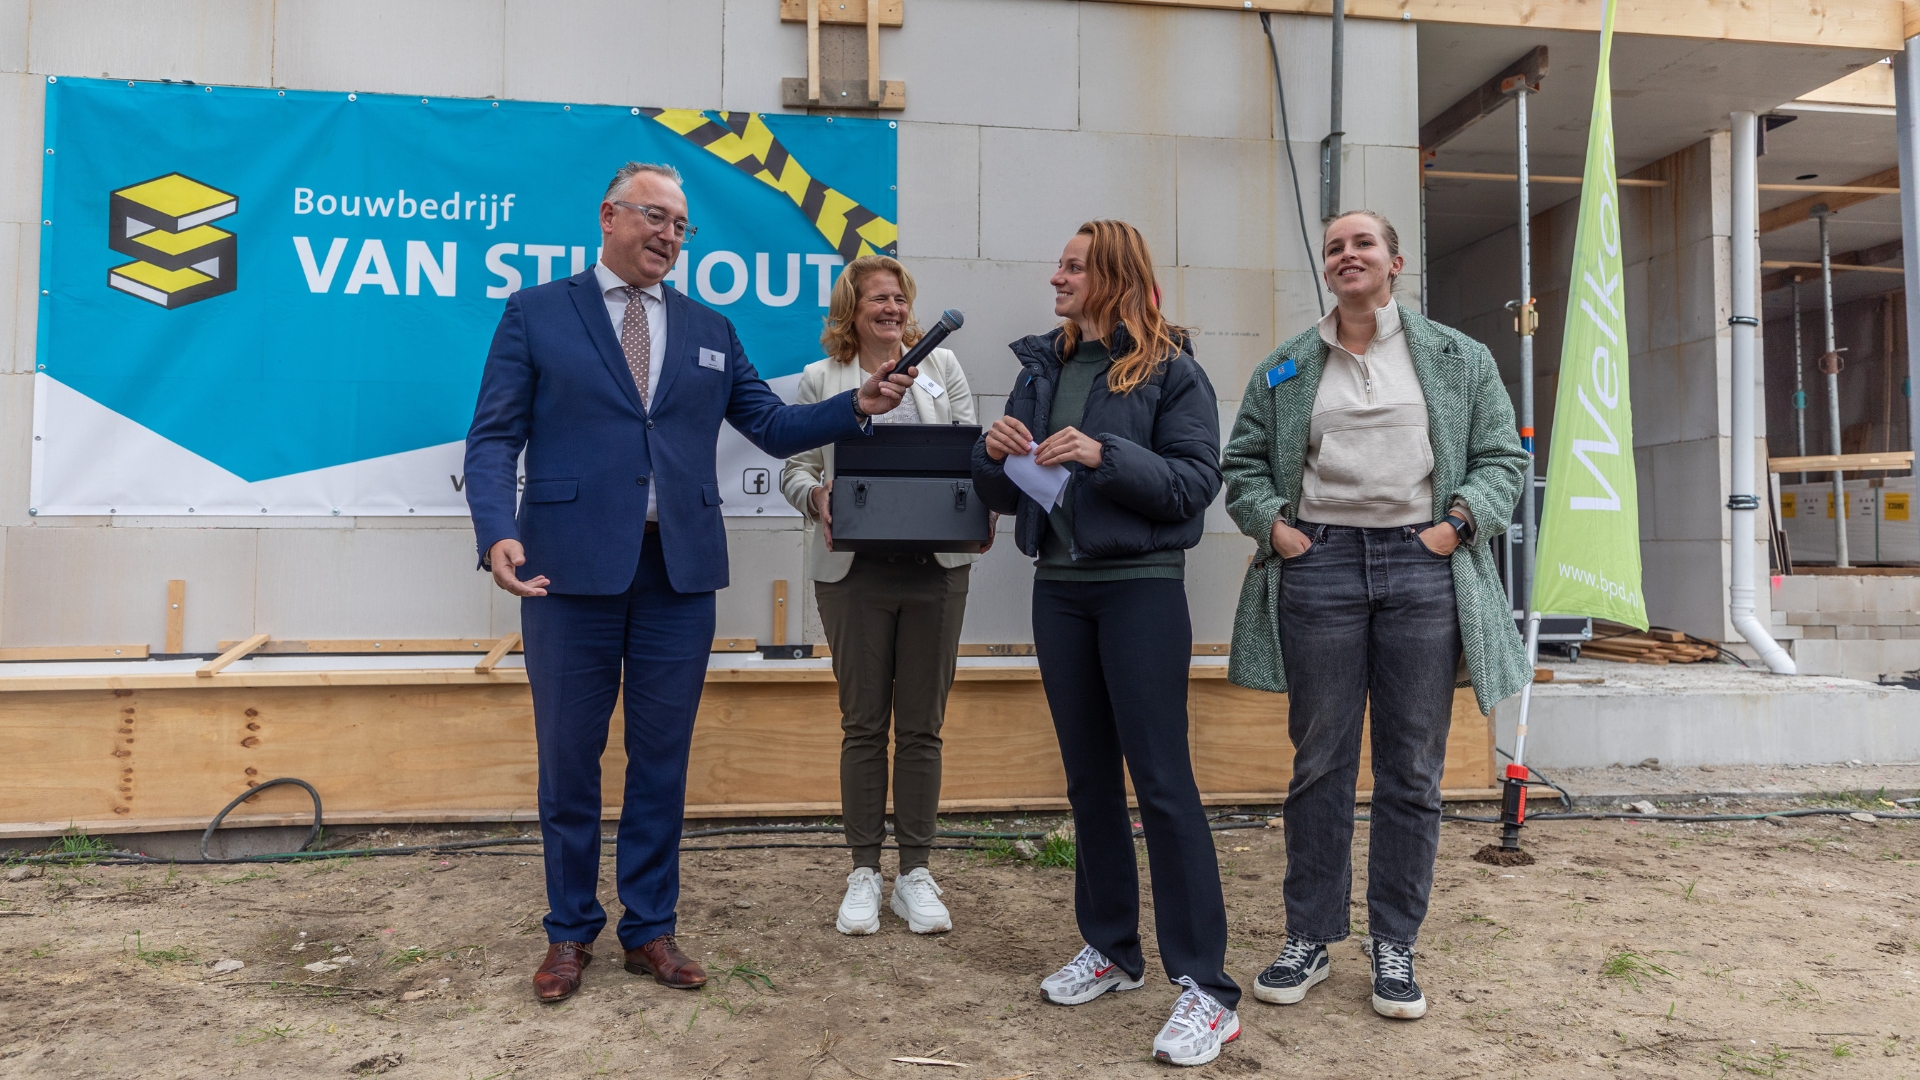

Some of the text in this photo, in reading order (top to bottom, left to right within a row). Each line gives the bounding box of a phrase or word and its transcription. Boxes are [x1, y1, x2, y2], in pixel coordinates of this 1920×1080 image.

[293, 187, 516, 230] Bouwbedrijf
[293, 236, 845, 308] VAN STIOUT
[1558, 561, 1639, 609] www.bpd.nl
